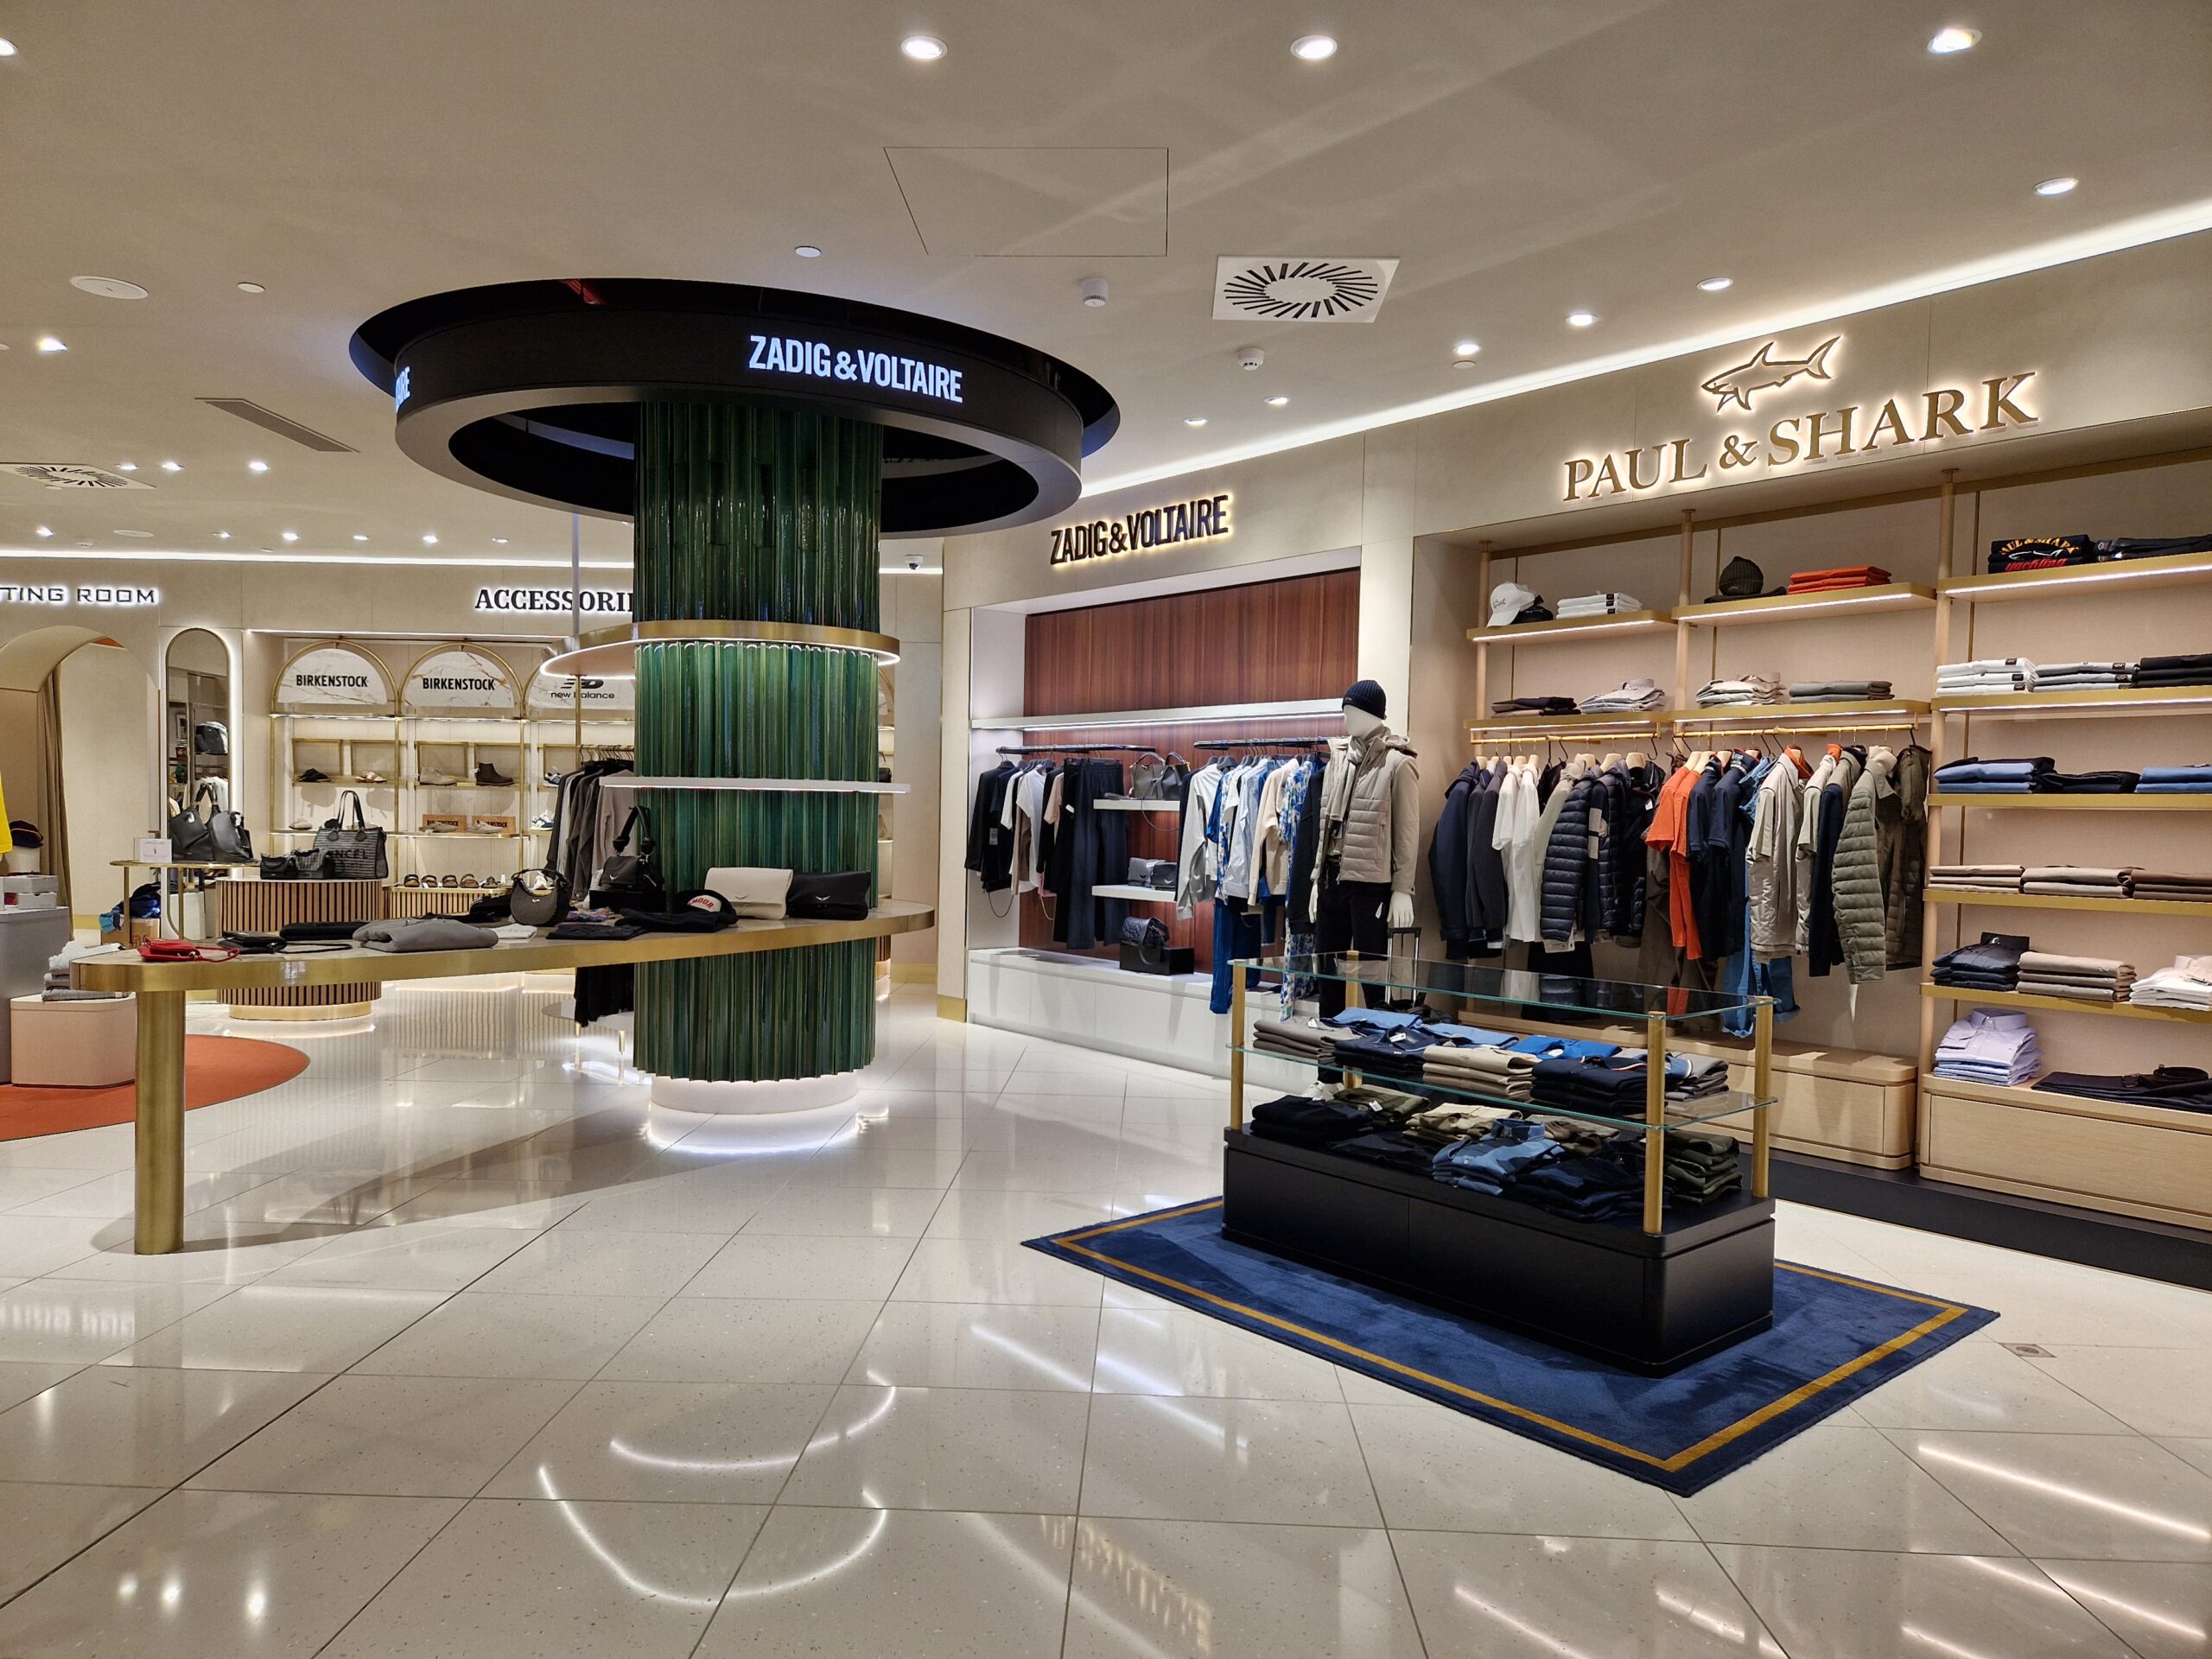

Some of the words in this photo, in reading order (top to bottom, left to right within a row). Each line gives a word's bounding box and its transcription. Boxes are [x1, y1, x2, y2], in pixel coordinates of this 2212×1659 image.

[1563, 438, 1707, 502] PAUL
[1719, 435, 1758, 469] &
[1767, 372, 2039, 467] SHARK
[77, 588, 154, 603] ROOM
[296, 675, 368, 688] BIRKENSTOCK
[423, 677, 495, 690] BIRKENSTOCK
